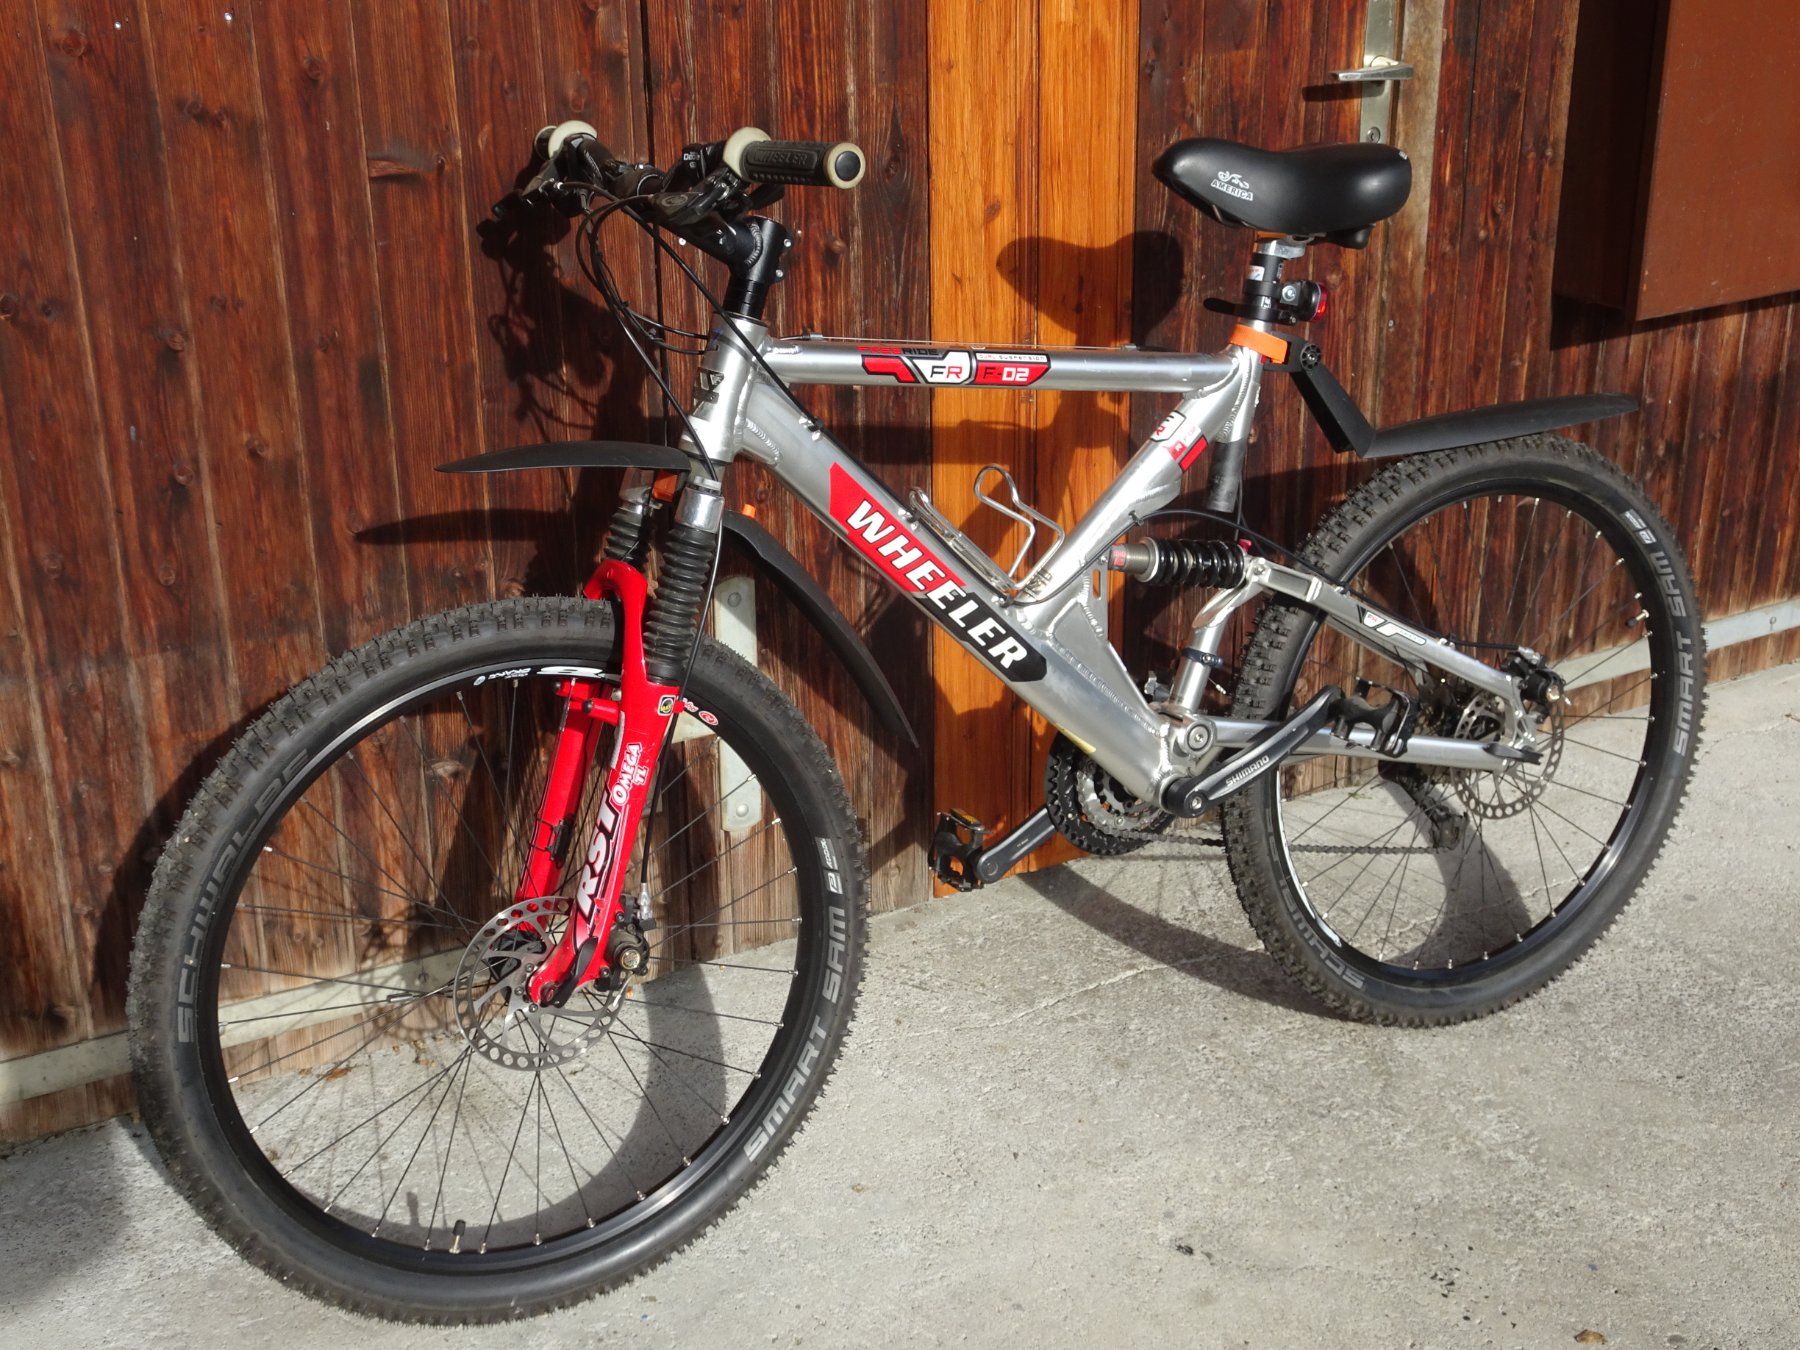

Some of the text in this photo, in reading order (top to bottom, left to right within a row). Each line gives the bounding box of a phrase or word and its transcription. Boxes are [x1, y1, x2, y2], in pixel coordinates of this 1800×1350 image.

[1211, 178, 1253, 201] AMERICA
[930, 365, 963, 379] FR
[846, 499, 1029, 670] WHEELER
[1650, 551, 1696, 758] SMART SAM
[609, 742, 642, 806] OMEGA
[1225, 753, 1271, 787] SHIMANO
[577, 791, 617, 920] RST
[742, 905, 847, 1163] SMART SAM
